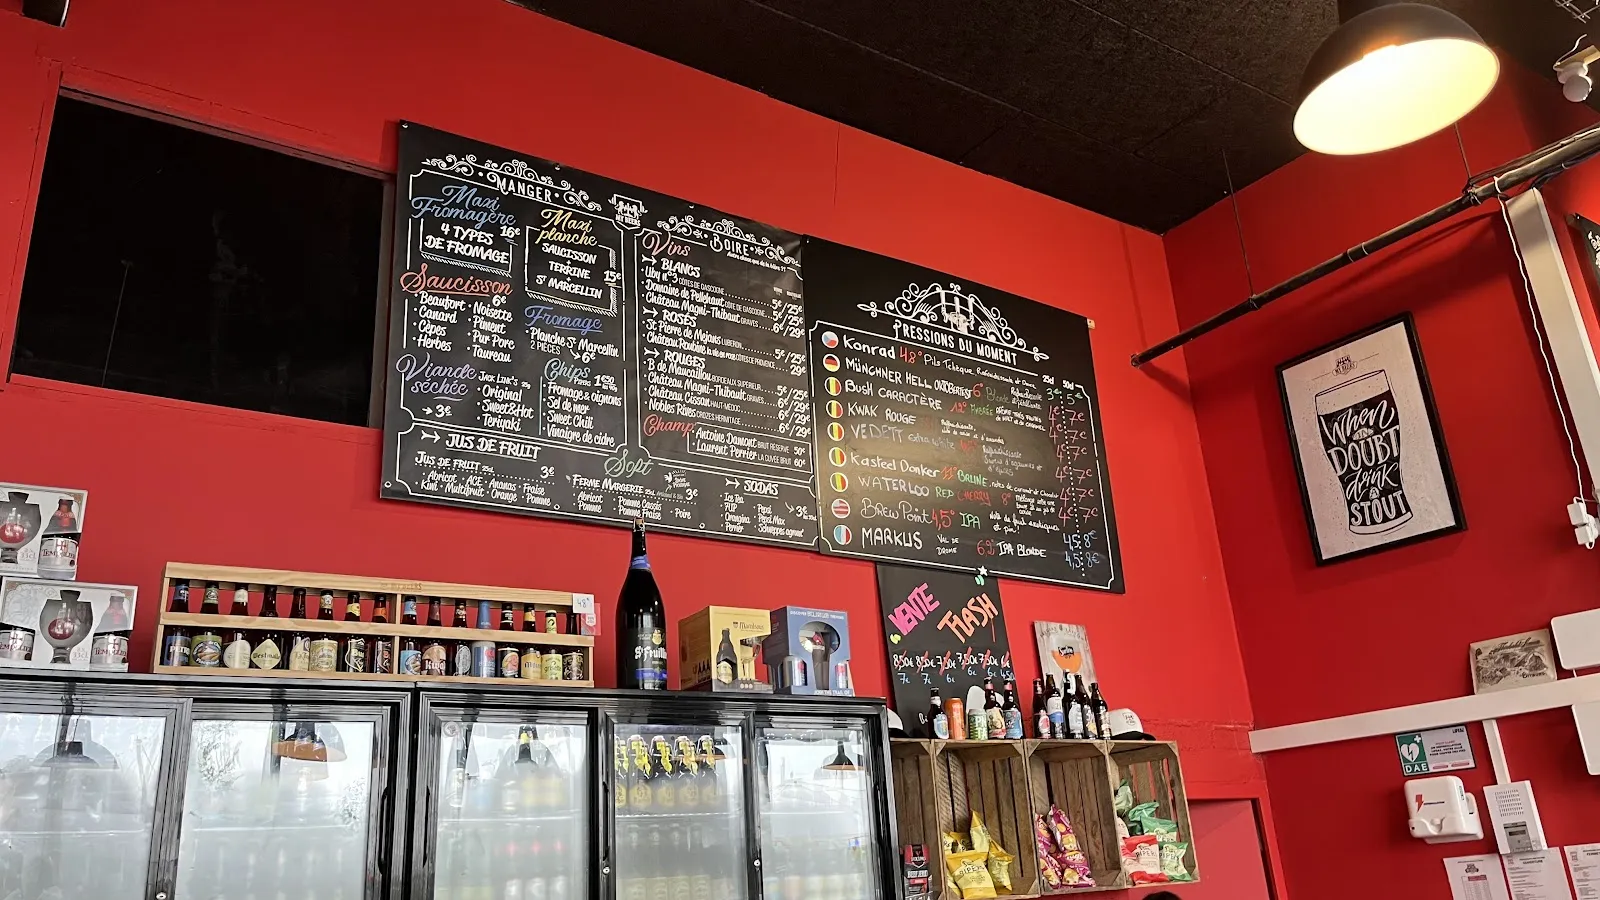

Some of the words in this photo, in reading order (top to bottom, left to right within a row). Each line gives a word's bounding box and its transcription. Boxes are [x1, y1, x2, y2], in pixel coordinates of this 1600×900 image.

[441, 184, 500, 212] Maxi
[487, 172, 552, 203] MANGER
[411, 196, 517, 230] Fromagère
[540, 208, 593, 233] Maxi
[440, 222, 450, 236] 4
[452, 225, 494, 246] TYPES
[500, 225, 521, 239] 16€
[534, 227, 598, 247] planche
[642, 230, 691, 257] Vins
[424, 234, 445, 250] DE
[446, 239, 510, 265] FROMAGE
[541, 242, 598, 265] SAUCISSON
[709, 232, 750, 257] BOIRE
[400, 263, 514, 296] Saucisson
[548, 260, 591, 281] TERRINE
[603, 269, 622, 284] 15€
[644, 265, 661, 282] Uby
[660, 257, 701, 279] BLANCS
[548, 277, 603, 299] MARCELLIN
[644, 279, 680, 298] Domaine
[680, 286, 690, 300] de
[420, 290, 467, 311] Beaufort
[473, 301, 513, 322] Noisette
[492, 294, 507, 308] 6€
[645, 292, 680, 311] Château
[418, 305, 458, 324] Canard
[472, 315, 507, 335] Piment
[524, 305, 603, 336] Fromage
[645, 318, 658, 331] St
[659, 320, 682, 337] Pierre
[682, 324, 694, 338] de
[662, 308, 697, 328] ROSÉS
[418, 320, 447, 338] Cèpes
[491, 334, 516, 350] Porc
[530, 326, 566, 348] Planche
[577, 338, 620, 358] Marcellin
[892, 319, 955, 349] PRESSIONS
[958, 337, 972, 353] DU
[976, 341, 1018, 366] MOMENT
[417, 334, 453, 352] Herbes
[472, 345, 512, 363] Taureau
[581, 352, 597, 364] 6€
[842, 334, 896, 360] Konrad
[396, 352, 478, 381] Viande
[543, 357, 591, 383] Chips
[647, 357, 656, 371] B
[657, 359, 667, 373] de
[663, 348, 706, 370] ROUGES
[647, 373, 683, 389] Château
[845, 356, 903, 385] MÜNCHNER
[905, 371, 933, 389] HELL
[410, 377, 469, 396] séchée
[481, 383, 523, 402] Original
[547, 381, 584, 402] Fromage
[591, 389, 622, 408] oignons
[648, 385, 684, 402] Château
[547, 395, 562, 409] Sel
[562, 398, 573, 412] de
[573, 403, 590, 415] mer
[648, 397, 675, 415] Nobles
[877, 387, 943, 410] CARACTÈRE
[482, 413, 522, 432] Teriyaki
[546, 410, 573, 426] Sweet
[573, 414, 594, 430] Chili
[847, 401, 879, 418] KWAK
[885, 407, 917, 425] ROUGE
[1319, 399, 1396, 445] When
[445, 432, 475, 450] JUS
[476, 437, 498, 452] DE
[498, 440, 542, 460] FRUIT
[546, 423, 582, 444] Vinaigre
[582, 430, 593, 444] de
[593, 432, 616, 448] cidre
[695, 427, 726, 443] Antoine
[414, 450, 436, 465] JUS
[437, 456, 451, 467] DE
[452, 458, 482, 471] FRUIT
[696, 439, 729, 456] Laurent
[729, 444, 758, 460] Perrier
[1327, 424, 1400, 477] DOUBT
[603, 448, 655, 478] Soft
[899, 458, 941, 478] Donker
[427, 469, 458, 483] Abricot
[488, 477, 517, 492] Ananas
[522, 482, 546, 496] Fraise
[572, 473, 601, 488] FERME
[743, 479, 780, 496] SODAS
[858, 476, 930, 497] WATERLOO
[1344, 462, 1399, 502] drink
[420, 479, 439, 492] Kiwi
[444, 481, 485, 498] Multifruit
[490, 488, 518, 504] Orange
[525, 492, 552, 507] Pomme
[577, 490, 604, 504] Abricot
[617, 495, 641, 509] Pomme
[641, 498, 663, 512] Cassis
[674, 507, 692, 520] Poire
[577, 500, 603, 514] Pomme
[618, 505, 641, 518] Pomme
[641, 508, 663, 521] Fraise
[1350, 490, 1407, 526] STOUT
[861, 527, 923, 550] MARKUS
[996, 540, 1015, 557] IPA
[887, 582, 941, 636] VENTE
[1404, 761, 1428, 773] DAE
